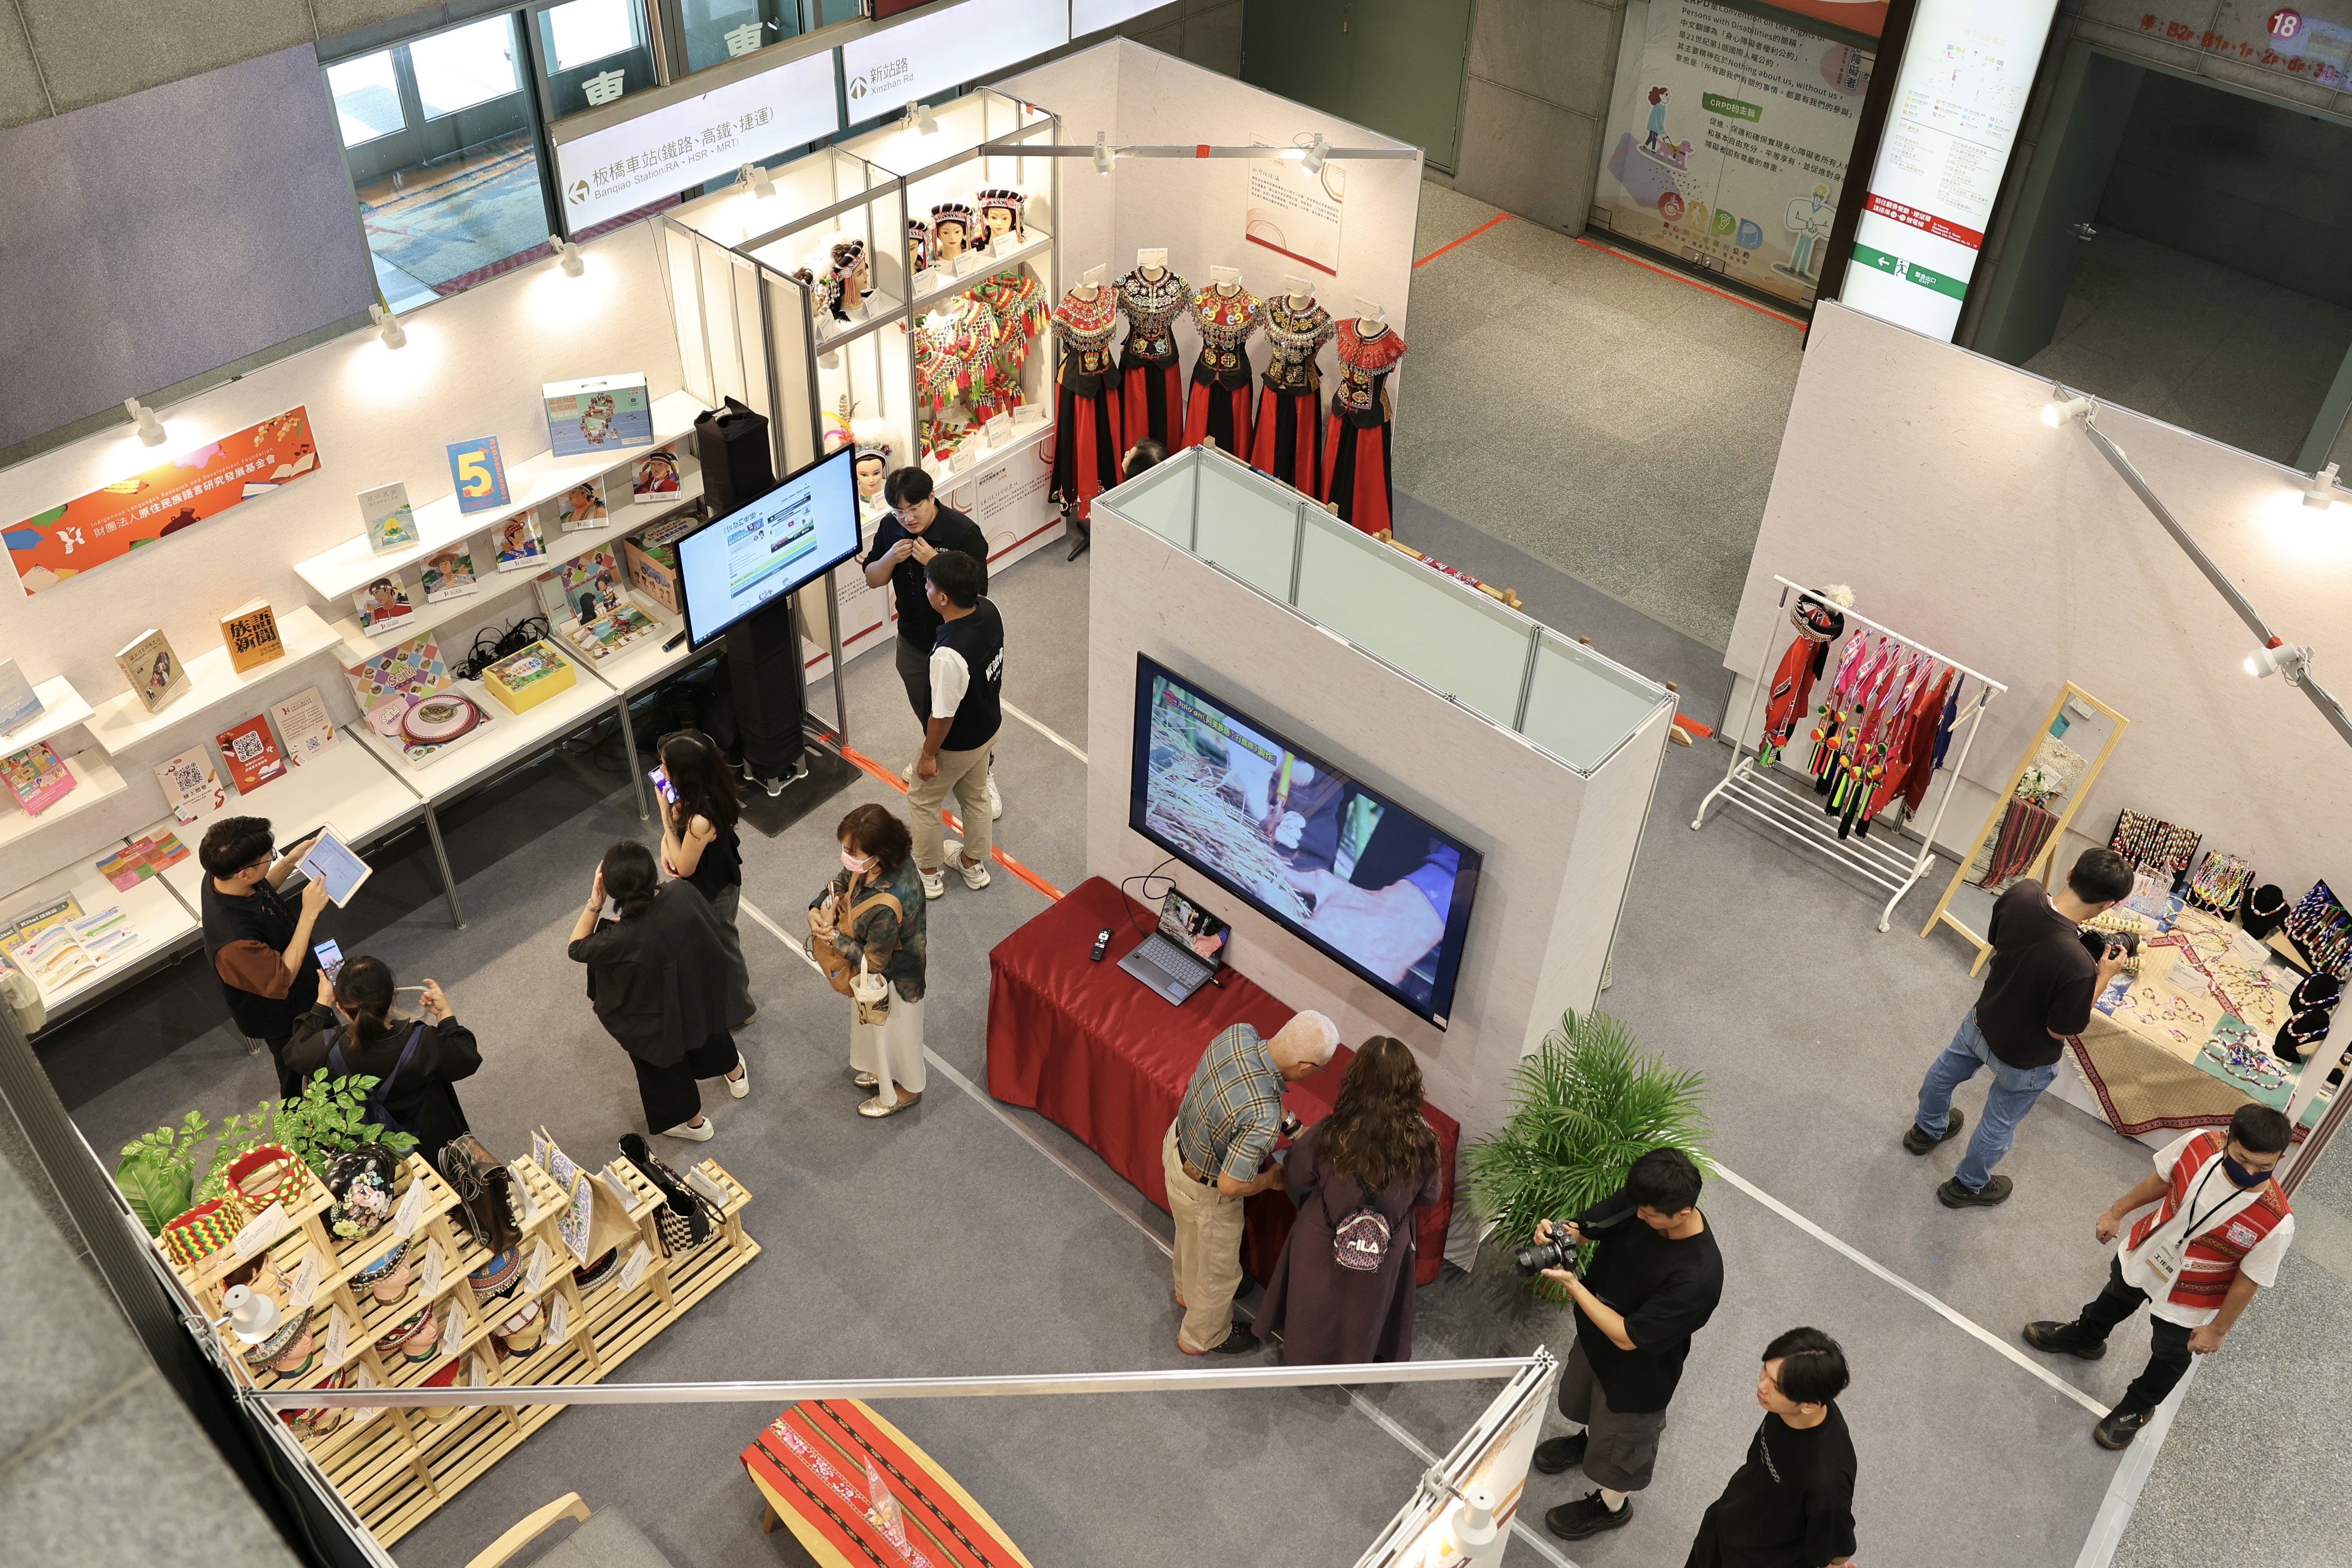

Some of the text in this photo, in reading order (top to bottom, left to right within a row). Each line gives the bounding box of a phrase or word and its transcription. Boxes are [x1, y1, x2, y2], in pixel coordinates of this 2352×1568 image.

[1682, 7, 1712, 22] Persons
[1713, 14, 1729, 27] with
[1684, 0, 1762, 23] RPD是Convention
[1763, 18, 1773, 27] on
[1775, 19, 1788, 32] the
[1790, 24, 1814, 40] Rights
[2273, 13, 2298, 38] 18
[870, 57, 908, 85] 新站路
[1676, 42, 1757, 75] 其主要精神在於Nothing
[1758, 69, 1781, 82] about
[1783, 76, 1794, 87] us,
[1796, 79, 1826, 96] without
[871, 73, 916, 96] Xinzhan Rd.
[1710, 98, 1756, 118] CRPD的主旨
[593, 106, 774, 187] 板橋車站(鐵路、高鐵、捷運)
[594, 179, 632, 201] Banqiao
[1948, 234, 1960, 243] Elevator
[1915, 271, 1937, 284] 緊急出口
[457, 451, 493, 498] 5
[91, 447, 273, 528] Indigenous Languages Research and Development Foundation
[93, 453, 276, 539] 財團法人原住民族語言研究發展基金會
[366, 488, 397, 502] 原住民族
[934, 545, 949, 554] ILRDF
[229, 610, 272, 640] 族語
[233, 625, 277, 655] 新聞
[20, 914, 39, 927] Kital
[1347, 1239, 1379, 1254] FILA
